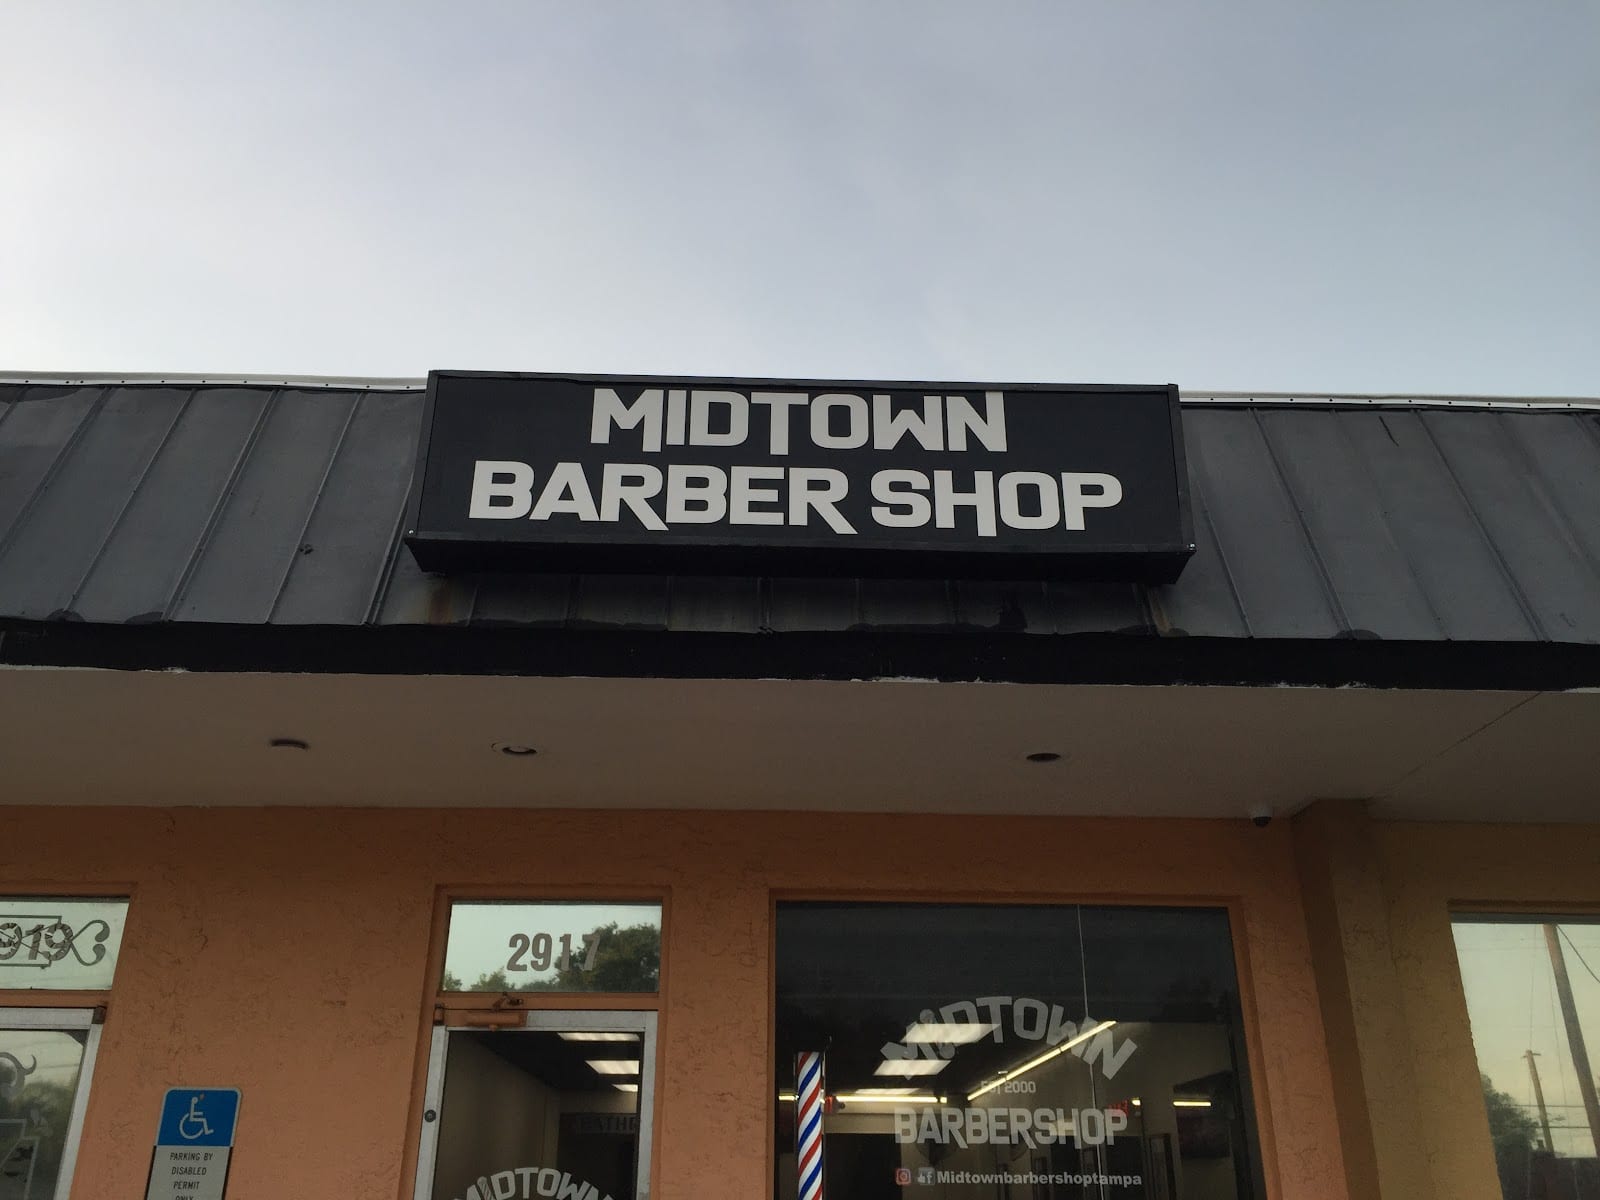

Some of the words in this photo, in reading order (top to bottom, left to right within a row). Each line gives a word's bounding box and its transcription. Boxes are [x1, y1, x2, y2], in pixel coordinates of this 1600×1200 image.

[590, 388, 1008, 455] MIDTOWN
[468, 460, 858, 535] BARBER
[871, 469, 1123, 537] SHOP
[507, 932, 600, 972] 2917
[880, 996, 1138, 1080] MIDTOWN
[1004, 1080, 1037, 1094] 2000
[894, 1107, 1128, 1150] BARBERSHOP
[170, 1152, 201, 1161] PARKING
[204, 1152, 214, 1161] BY
[171, 1166, 207, 1176] DISABLED
[937, 1171, 1143, 1188] Midtownbarbershoptampa
[173, 1181, 200, 1190] PERMIT
